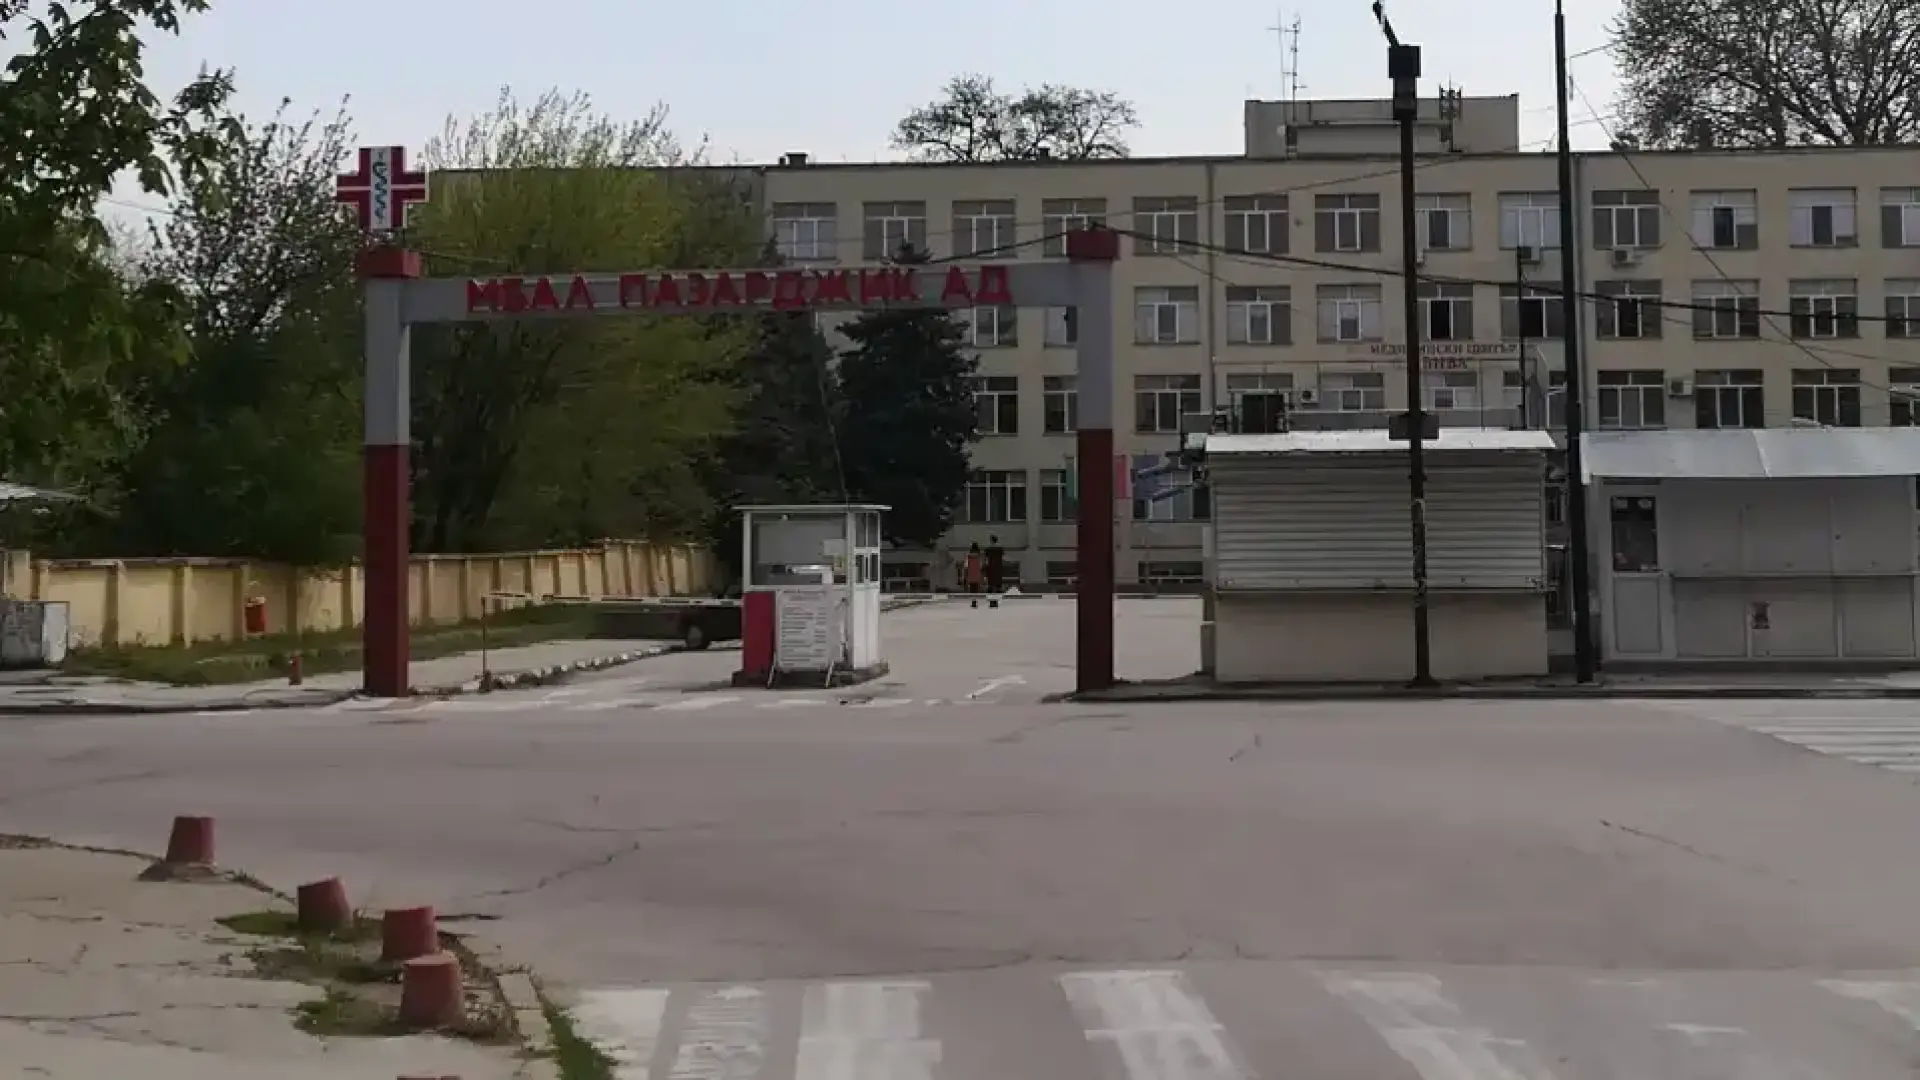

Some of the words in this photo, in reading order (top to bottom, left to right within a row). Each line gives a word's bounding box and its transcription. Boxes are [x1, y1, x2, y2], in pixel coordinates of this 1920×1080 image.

[467, 274, 594, 313] МБАЛ
[619, 270, 922, 310] ПАЗАРДЖИК
[942, 264, 1014, 307] АД
[1370, 343, 1462, 355] МЕДИИНСКИ
